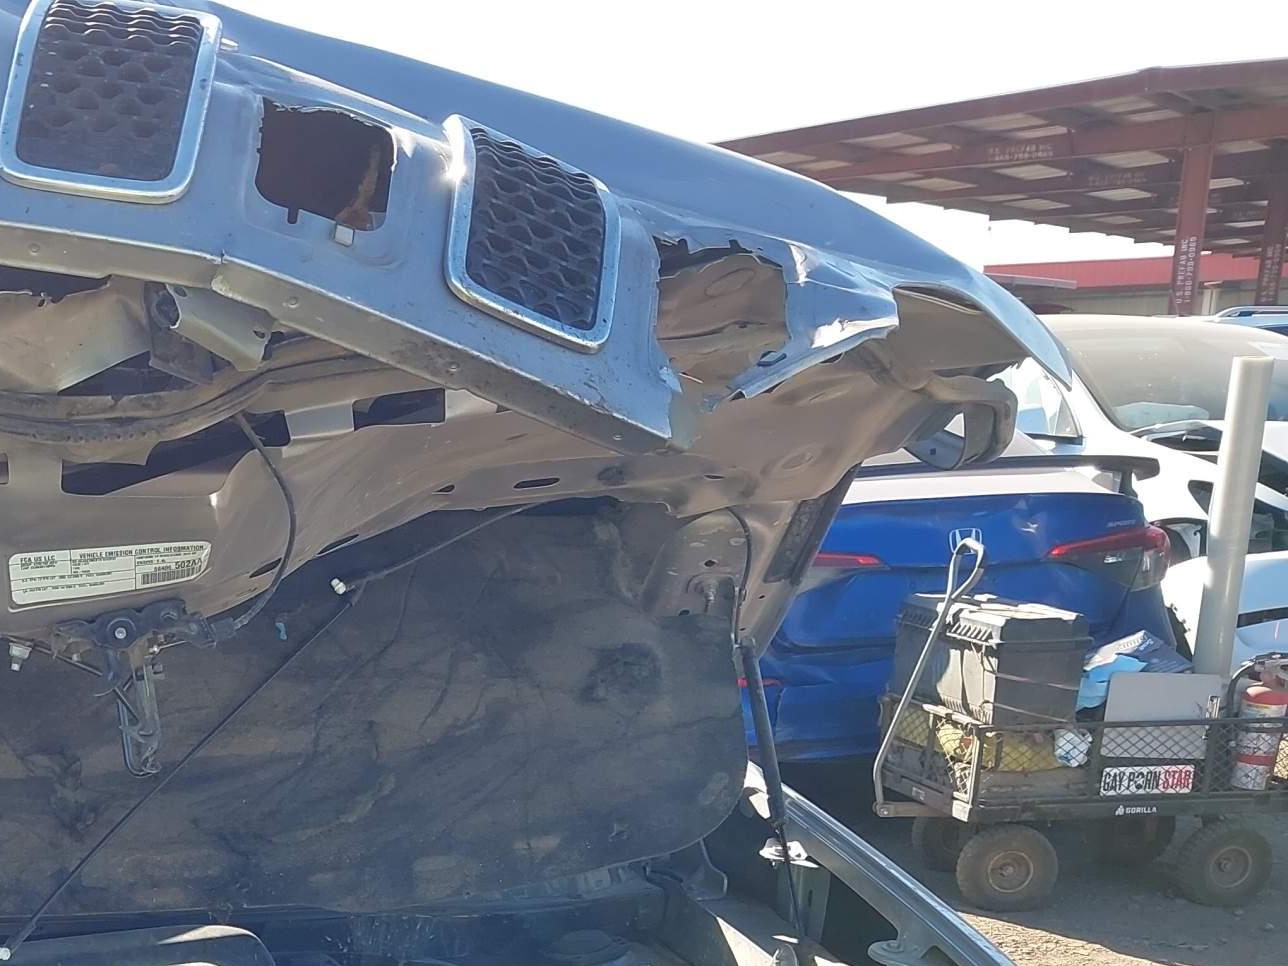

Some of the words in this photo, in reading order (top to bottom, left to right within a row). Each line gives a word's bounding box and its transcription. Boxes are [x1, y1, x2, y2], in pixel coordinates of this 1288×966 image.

[1177, 254, 1187, 285] PREFAB
[104, 549, 133, 558] EMISSION
[134, 547, 161, 555] CONTROL
[164, 544, 204, 553] INFORMATION
[1162, 769, 1192, 790] STAR
[1125, 806, 1157, 814] GORILLA
